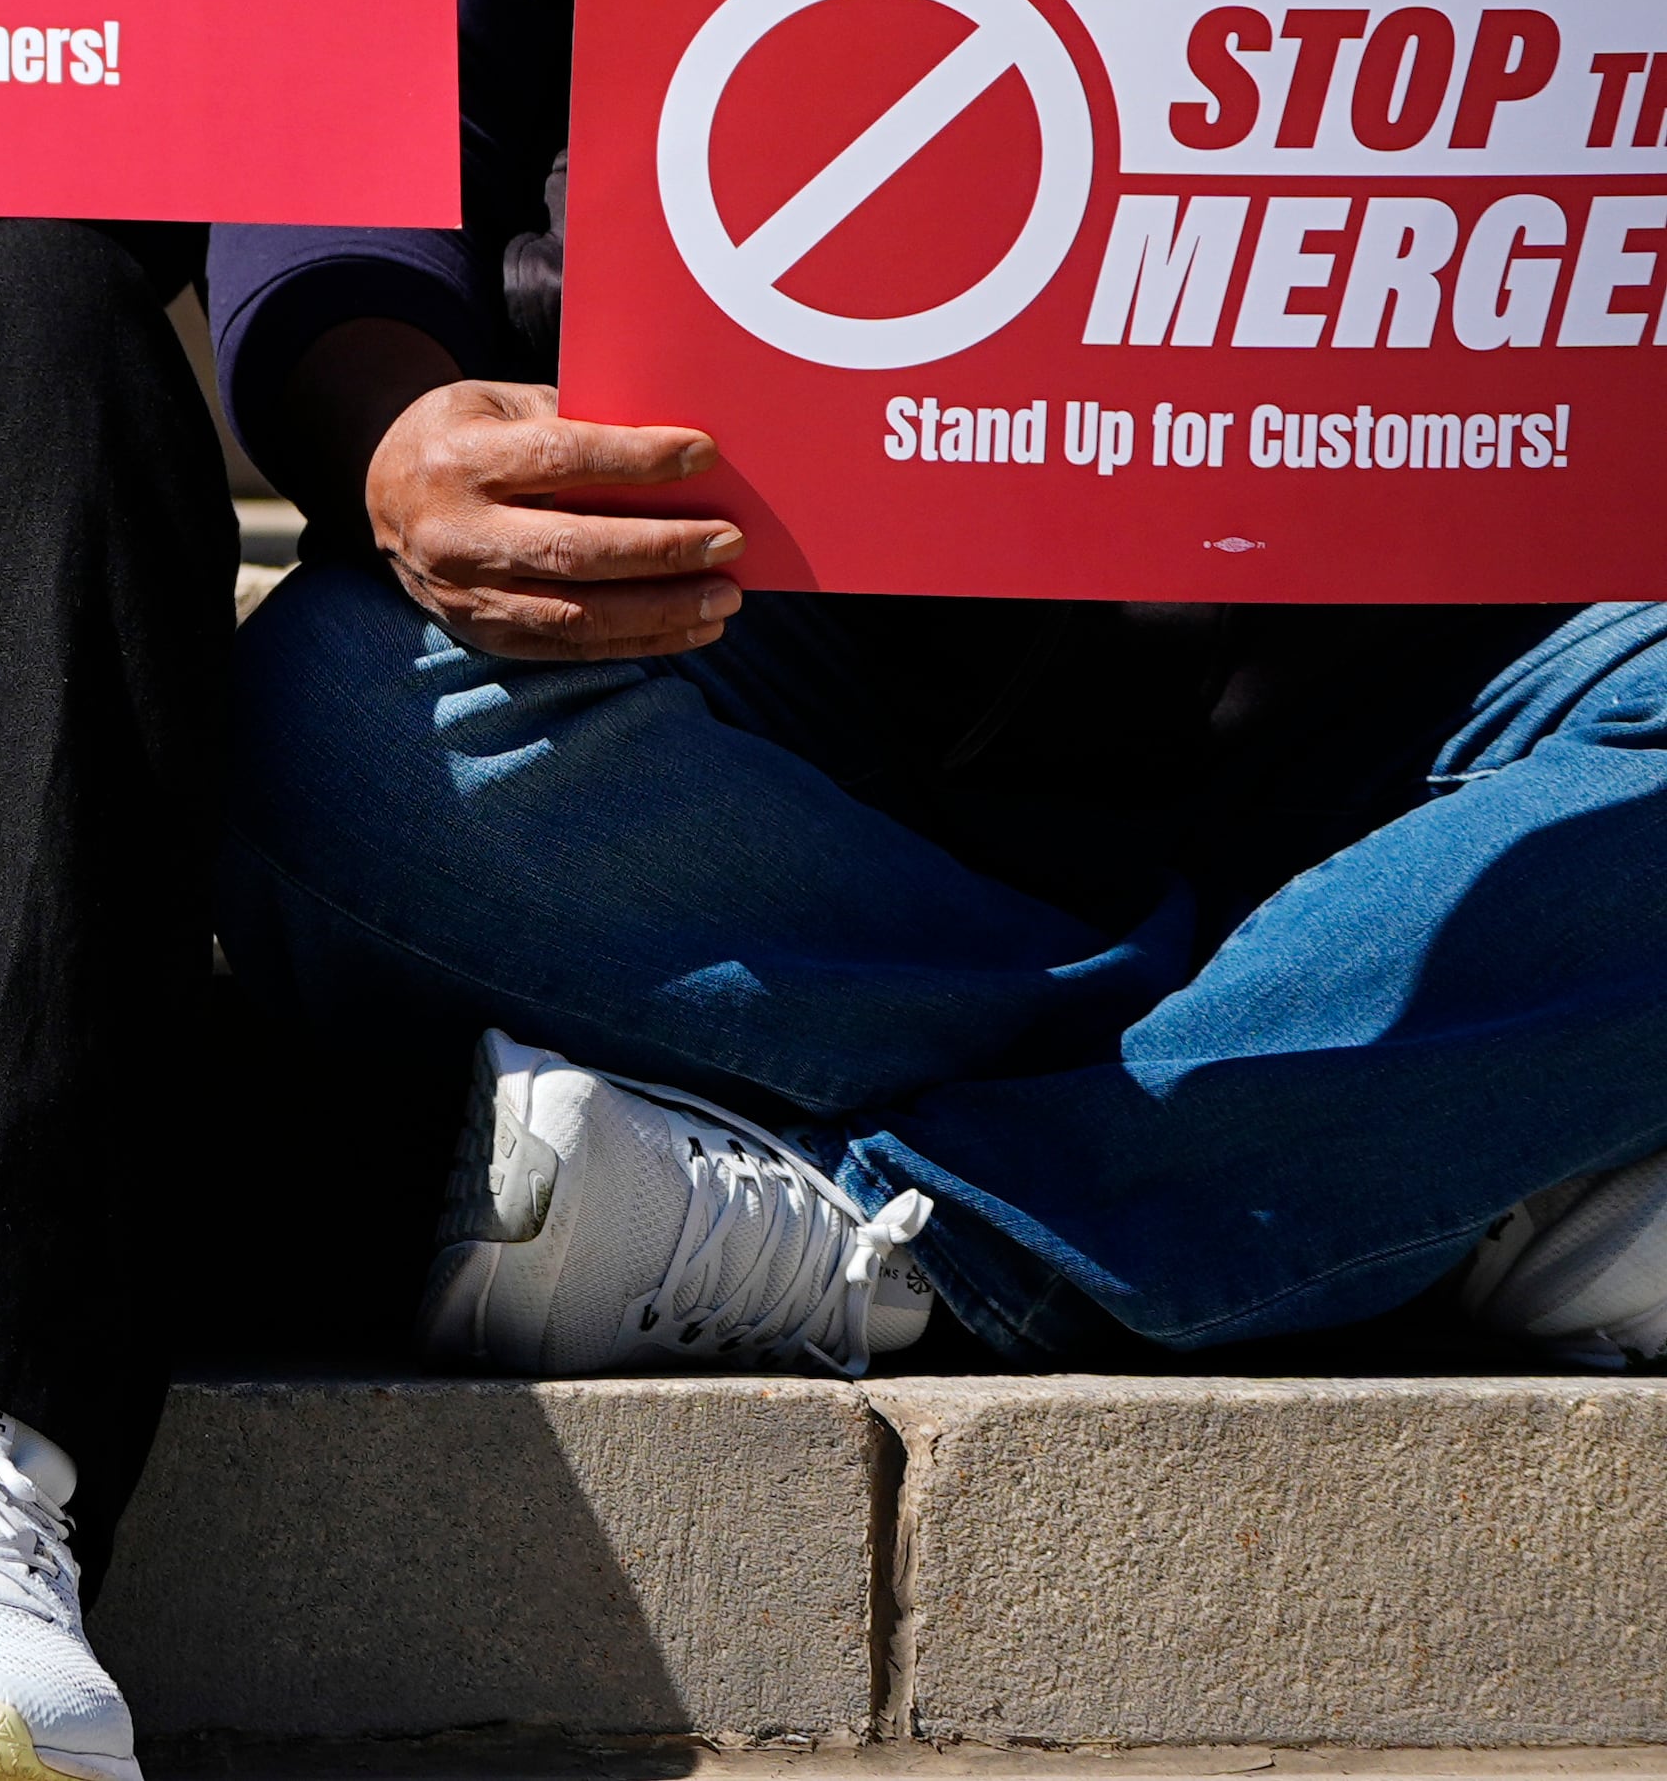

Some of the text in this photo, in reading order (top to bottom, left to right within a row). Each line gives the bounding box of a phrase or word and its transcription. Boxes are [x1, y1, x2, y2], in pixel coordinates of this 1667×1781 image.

[1168, 5, 1561, 152] STOP
[1081, 193, 1667, 351] MERGE
[883, 395, 1570, 476] Stand Up for Customers!
